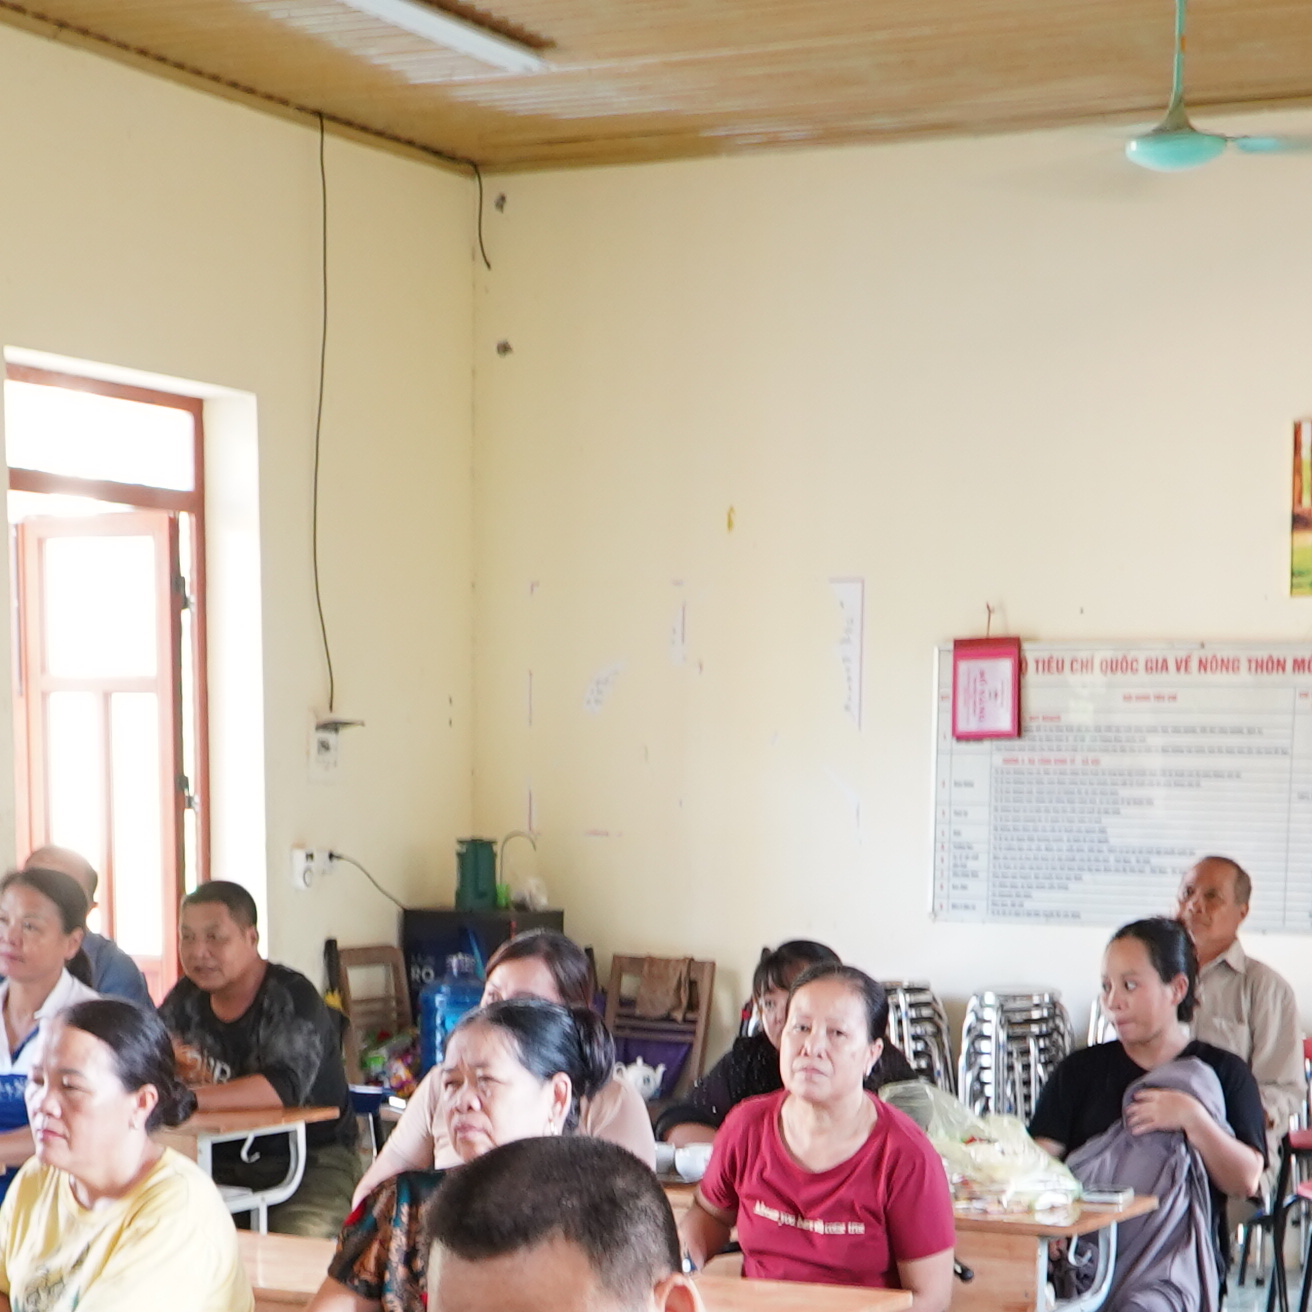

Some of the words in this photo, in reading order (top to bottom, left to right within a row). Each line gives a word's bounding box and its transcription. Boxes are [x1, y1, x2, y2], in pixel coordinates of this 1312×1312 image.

[1034, 655, 1065, 675] TIÊU
[1070, 653, 1095, 675] CHÍ
[1144, 656, 1170, 675] GIA
[1198, 654, 1241, 675] NÔNG
[1247, 655, 1287, 675] THÔN
